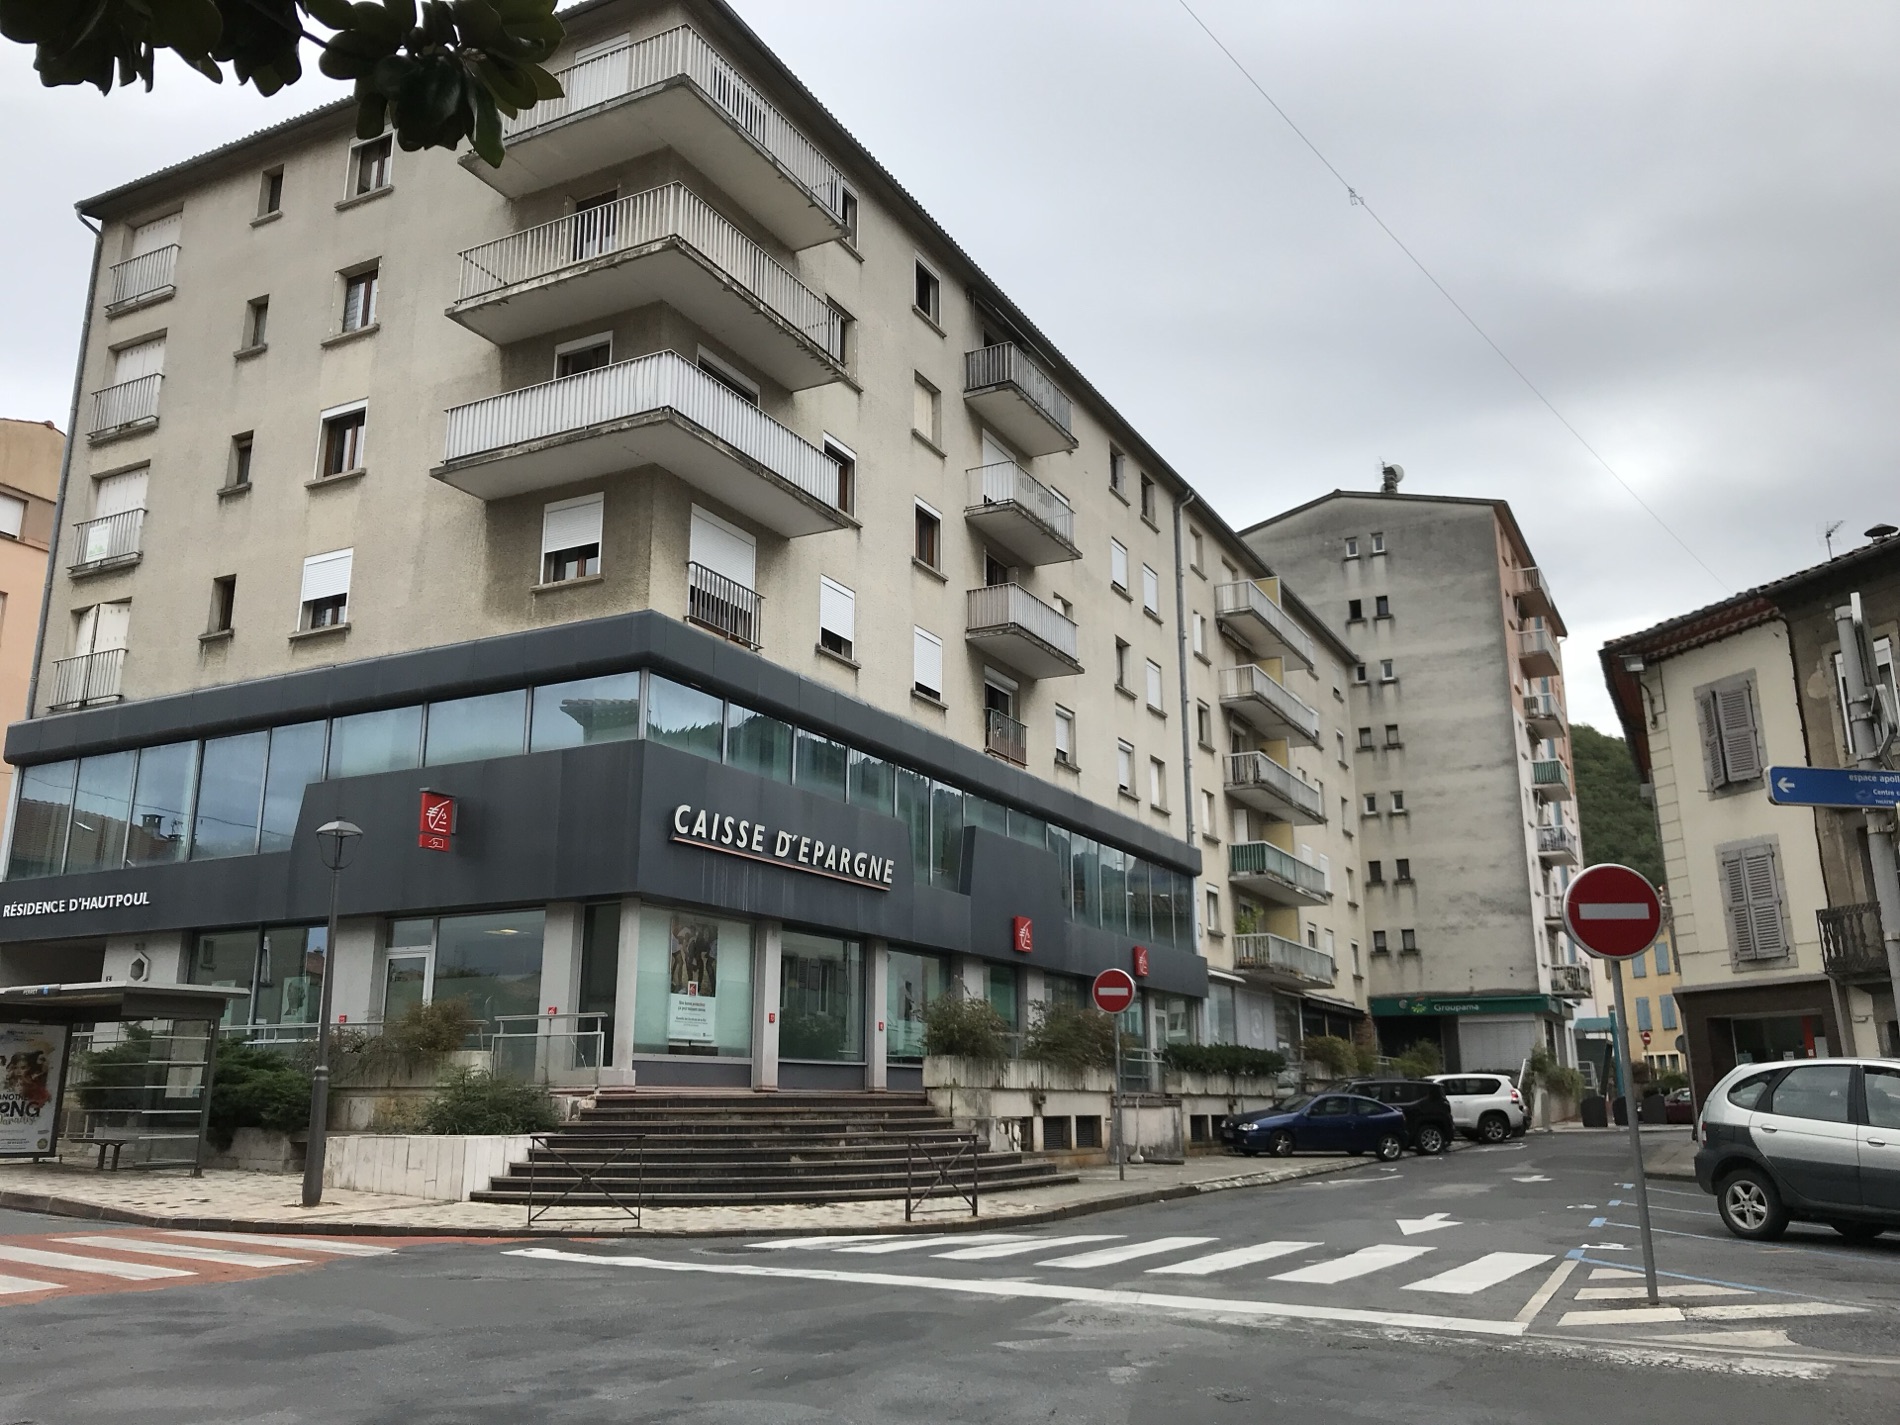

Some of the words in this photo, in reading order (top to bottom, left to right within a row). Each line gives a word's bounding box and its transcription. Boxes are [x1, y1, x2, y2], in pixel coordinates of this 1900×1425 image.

[1849, 774, 1877, 782] espace
[1872, 788, 1895, 796] Centre
[674, 804, 766, 852] CAISSE
[774, 829, 895, 884] D'EPARGNE
[2, 901, 66, 918] RÉSIDENCE
[68, 891, 151, 912] D'HAUTPOUL
[1433, 1004, 1479, 1012] Groupama
